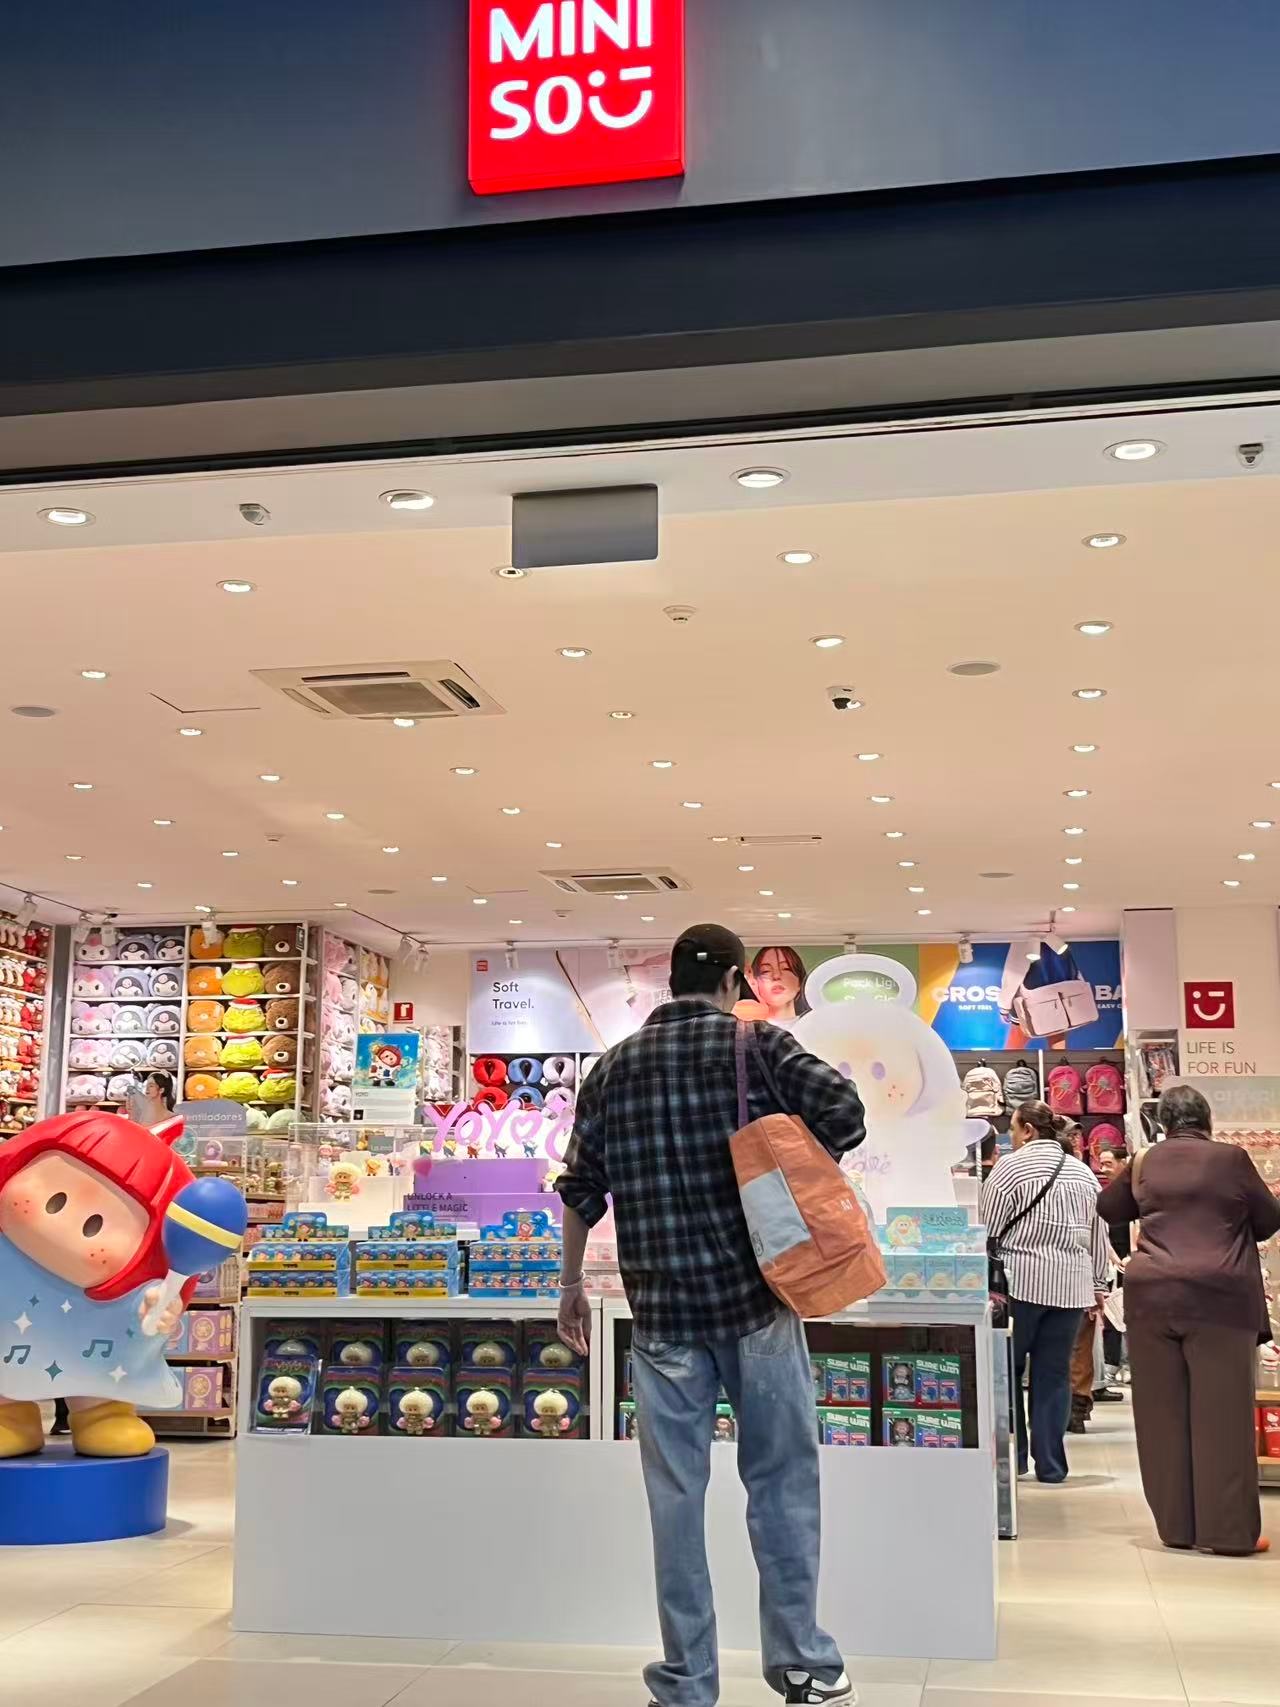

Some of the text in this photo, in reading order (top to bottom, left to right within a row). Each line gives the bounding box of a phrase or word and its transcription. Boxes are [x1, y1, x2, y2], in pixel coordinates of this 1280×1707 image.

[489, 0, 652, 63] MINI
[492, 981, 519, 992] Soft
[492, 998, 535, 1010] Travel.
[1187, 1041, 1235, 1055] LIFE IS
[1187, 1061, 1256, 1075] FOR FUN
[439, 1203, 469, 1212] MAGIC
